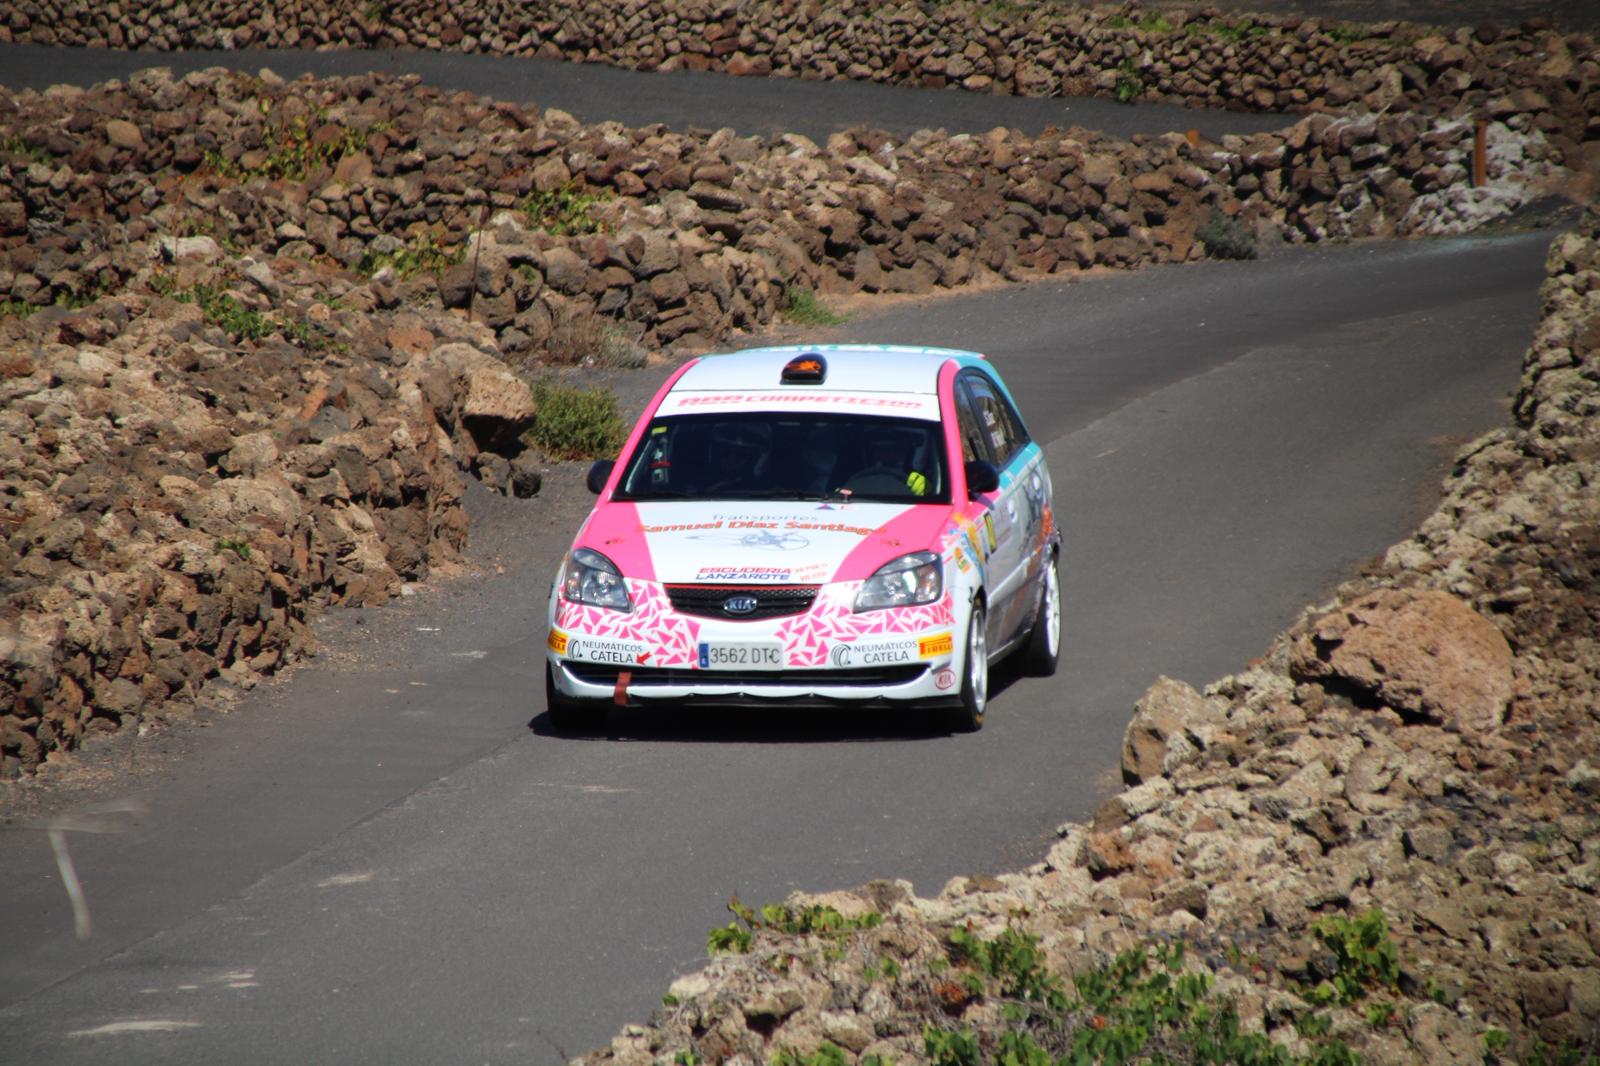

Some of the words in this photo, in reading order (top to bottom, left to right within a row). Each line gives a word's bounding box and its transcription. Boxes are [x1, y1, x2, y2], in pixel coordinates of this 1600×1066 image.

[635, 521, 723, 532] Samuel
[728, 599, 753, 610] KIA
[590, 650, 634, 664] CATELA
[710, 648, 748, 664] 3562
[751, 648, 781, 664] DTC
[863, 651, 910, 665] CATELA
